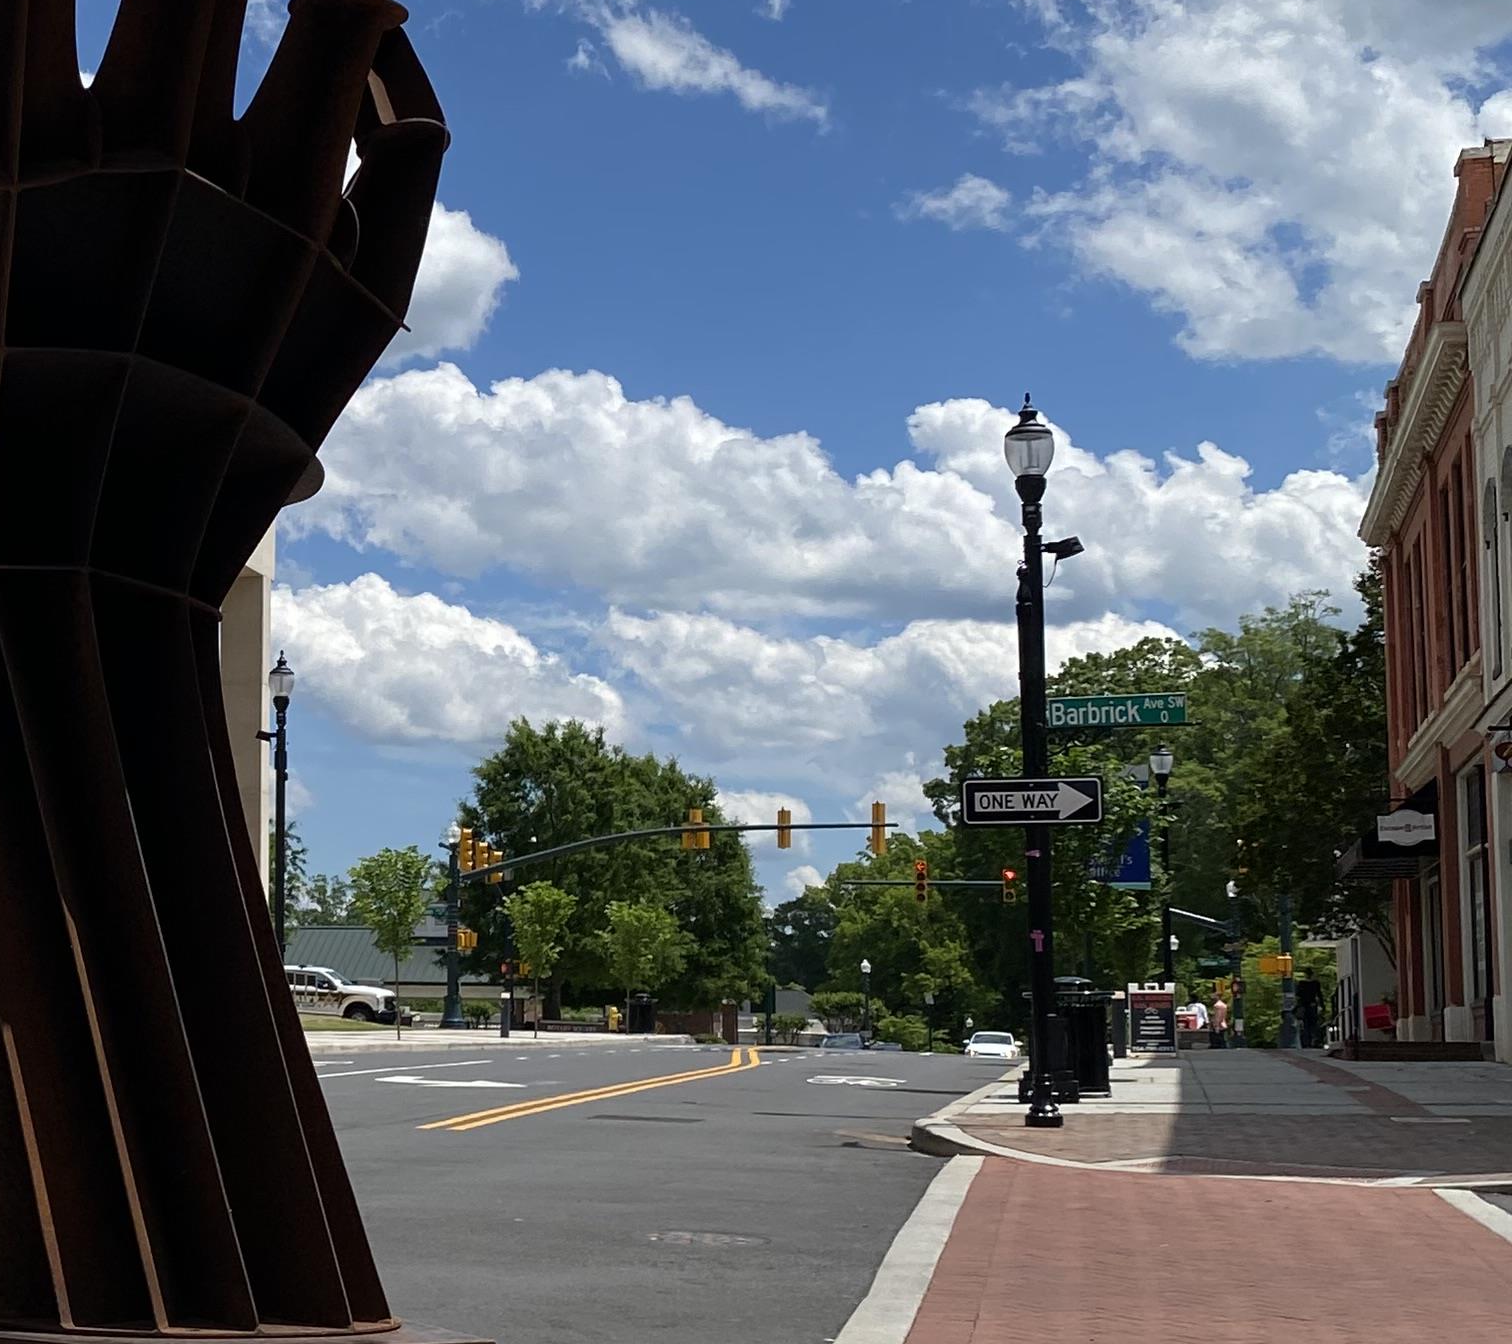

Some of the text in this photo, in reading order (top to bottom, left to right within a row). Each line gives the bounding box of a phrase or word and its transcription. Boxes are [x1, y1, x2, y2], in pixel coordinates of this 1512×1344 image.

[1051, 695, 1184, 726] Barbrick Ave SW
[979, 791, 1059, 810] ONE WAY
